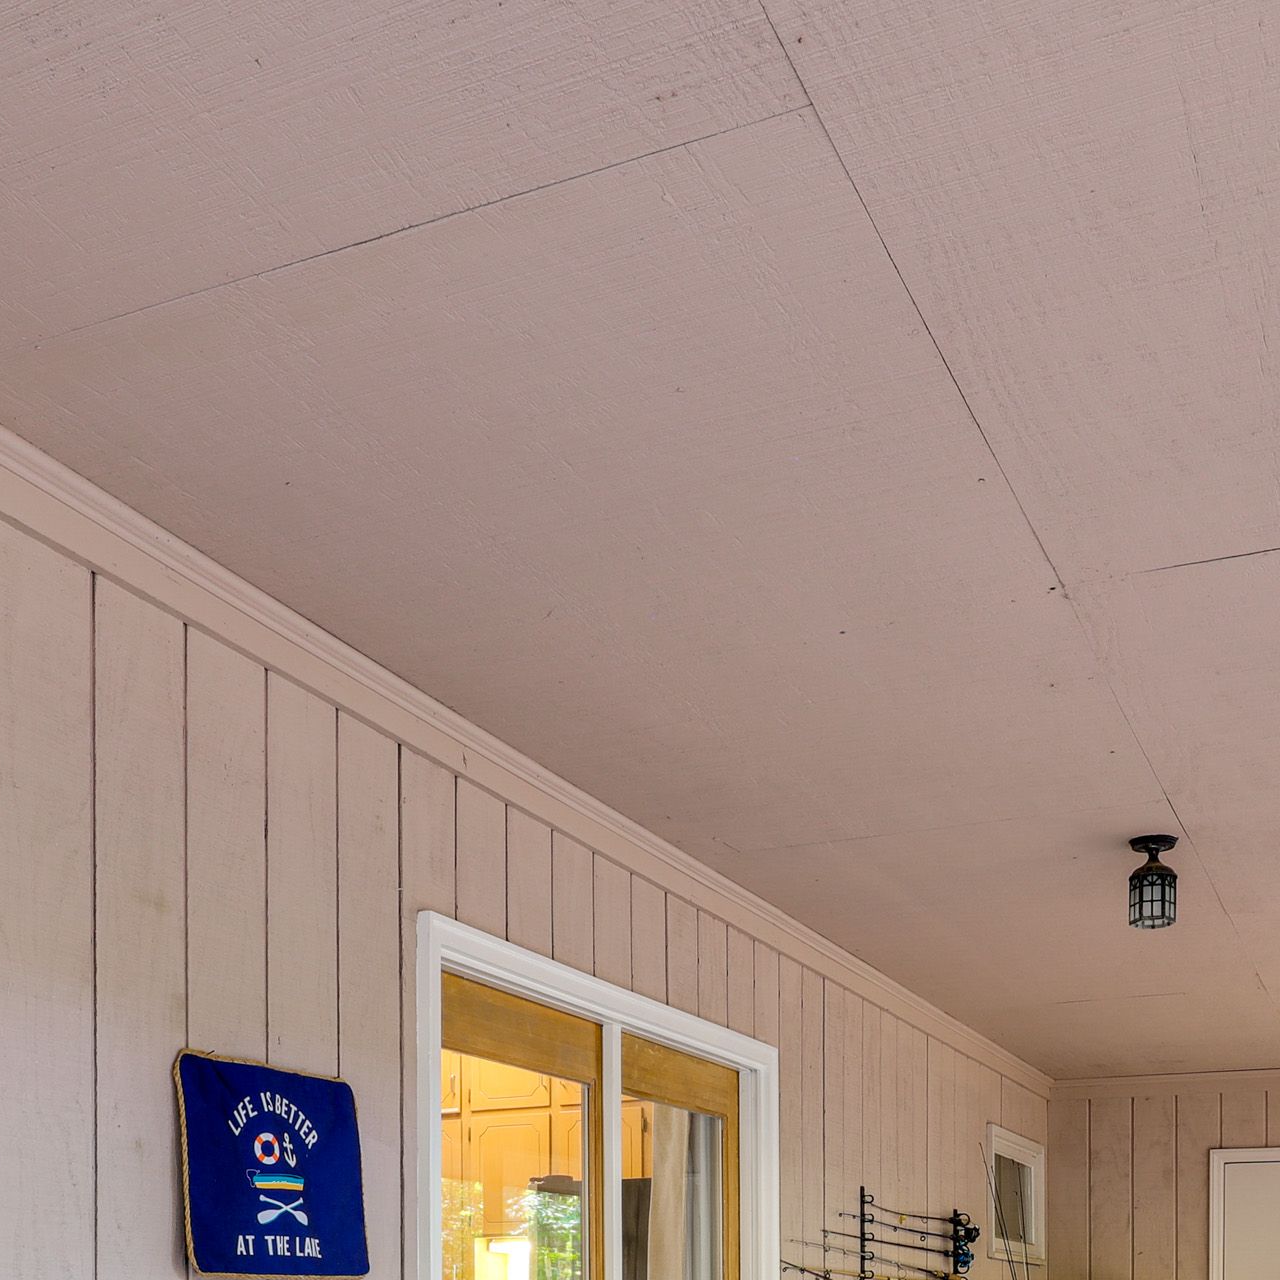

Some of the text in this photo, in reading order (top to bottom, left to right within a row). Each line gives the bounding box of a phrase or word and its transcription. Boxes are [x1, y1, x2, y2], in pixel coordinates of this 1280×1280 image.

[228, 1091, 318, 1149] LIFE IS BETTER
[237, 1235, 255, 1256] AT
[264, 1235, 291, 1256] THE
